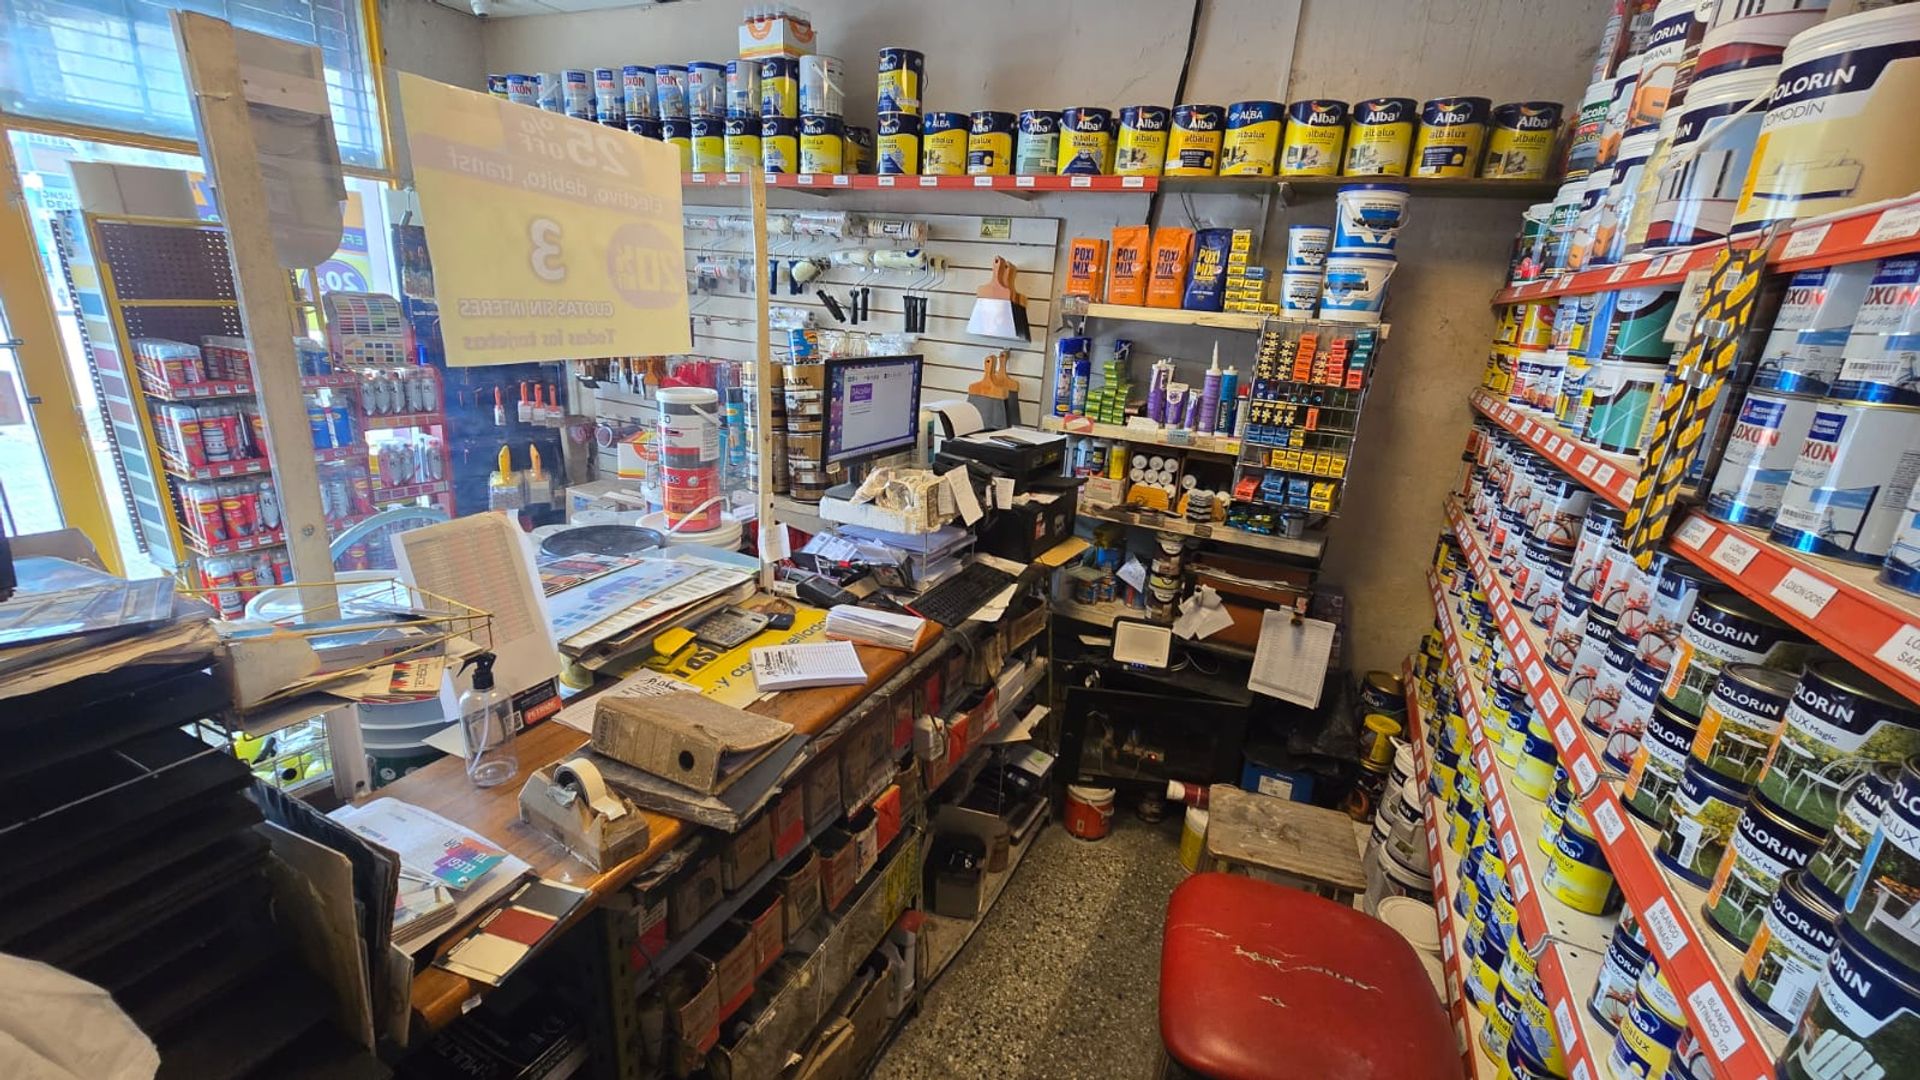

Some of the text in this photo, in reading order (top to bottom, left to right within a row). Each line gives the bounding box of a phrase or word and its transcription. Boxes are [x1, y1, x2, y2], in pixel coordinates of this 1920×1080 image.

[1239, 110, 1264, 120] ALBA
[1308, 112, 1336, 124] Alba
[1365, 112, 1395, 123] Alba
[1434, 112, 1465, 124] Alba
[1028, 124, 1048, 132] Alba
[1077, 121, 1099, 131] Alba
[1136, 119, 1160, 129] Alba
[1189, 119, 1214, 130] Alba
[1517, 116, 1549, 129] Alba
[1075, 246, 1094, 261] POXI
[1116, 247, 1138, 261] POXI
[1158, 248, 1180, 262] POXI
[1198, 248, 1221, 264] POXI
[1072, 262, 1090, 274] MIX
[1115, 262, 1133, 274] MIX
[1156, 262, 1174, 274] MIX
[1195, 262, 1214, 278] MIX
[1781, 579, 1808, 600] LOXON
[1659, 907, 1679, 940] BLANCO
[1708, 996, 1731, 1034] BLANCO
